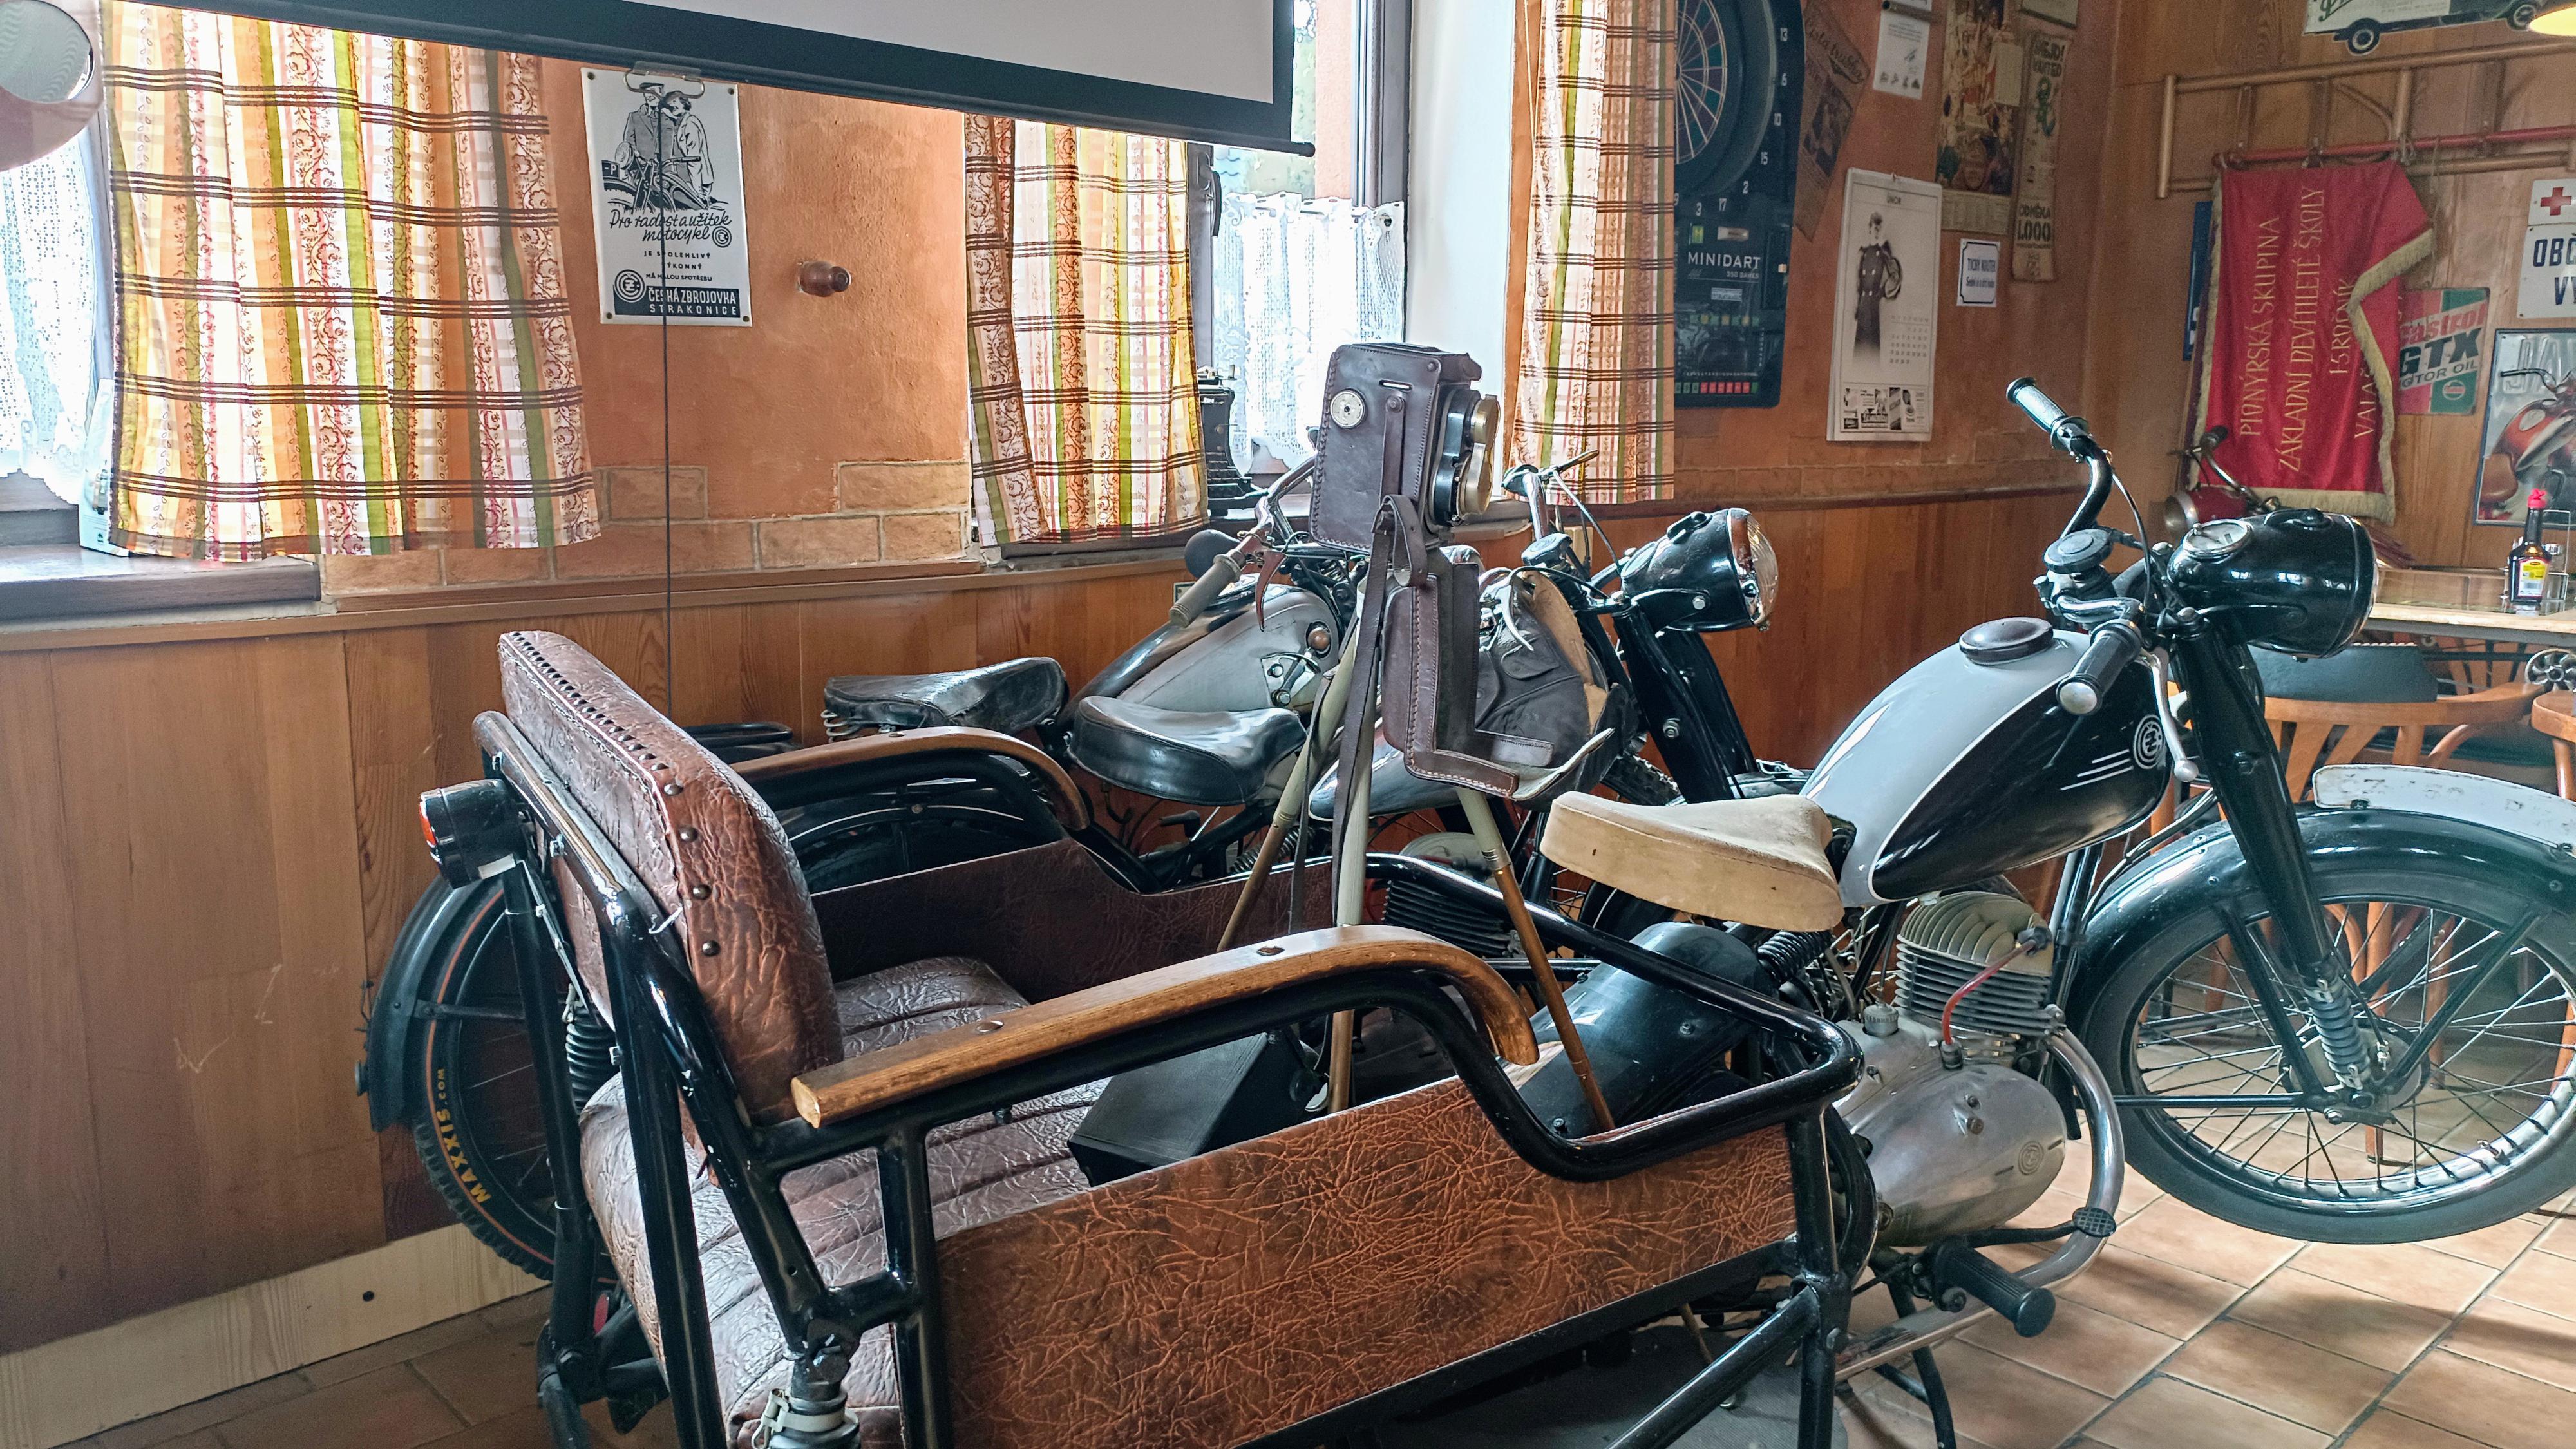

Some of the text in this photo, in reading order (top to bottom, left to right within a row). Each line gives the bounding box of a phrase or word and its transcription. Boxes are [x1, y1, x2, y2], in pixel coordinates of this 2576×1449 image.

[1780, 28, 1788, 41] 13
[1781, 73, 1787, 86] 6
[1774, 113, 1781, 126] 10
[1761, 151, 1768, 165] 15
[1743, 181, 1748, 193] 2
[1696, 202, 1702, 216] 3
[1719, 198, 1727, 211] 17
[610, 209, 632, 229] Pro
[689, 211, 732, 227] užitek
[642, 226, 710, 244] motocykl
[1687, 251, 1761, 269] MINIDART
[681, 290, 737, 305] ZBROJOVKA
[649, 303, 737, 316] STRAKONICE
[2239, 217, 2280, 436] PIONÝRSKÁ SKUPINA
[2275, 185, 2324, 472] ZÁKLADNÍ DEVÍTILETÉ ŠKOLY
[2400, 328, 2482, 377] GTX
[2401, 360, 2479, 387] OTOR OIL
